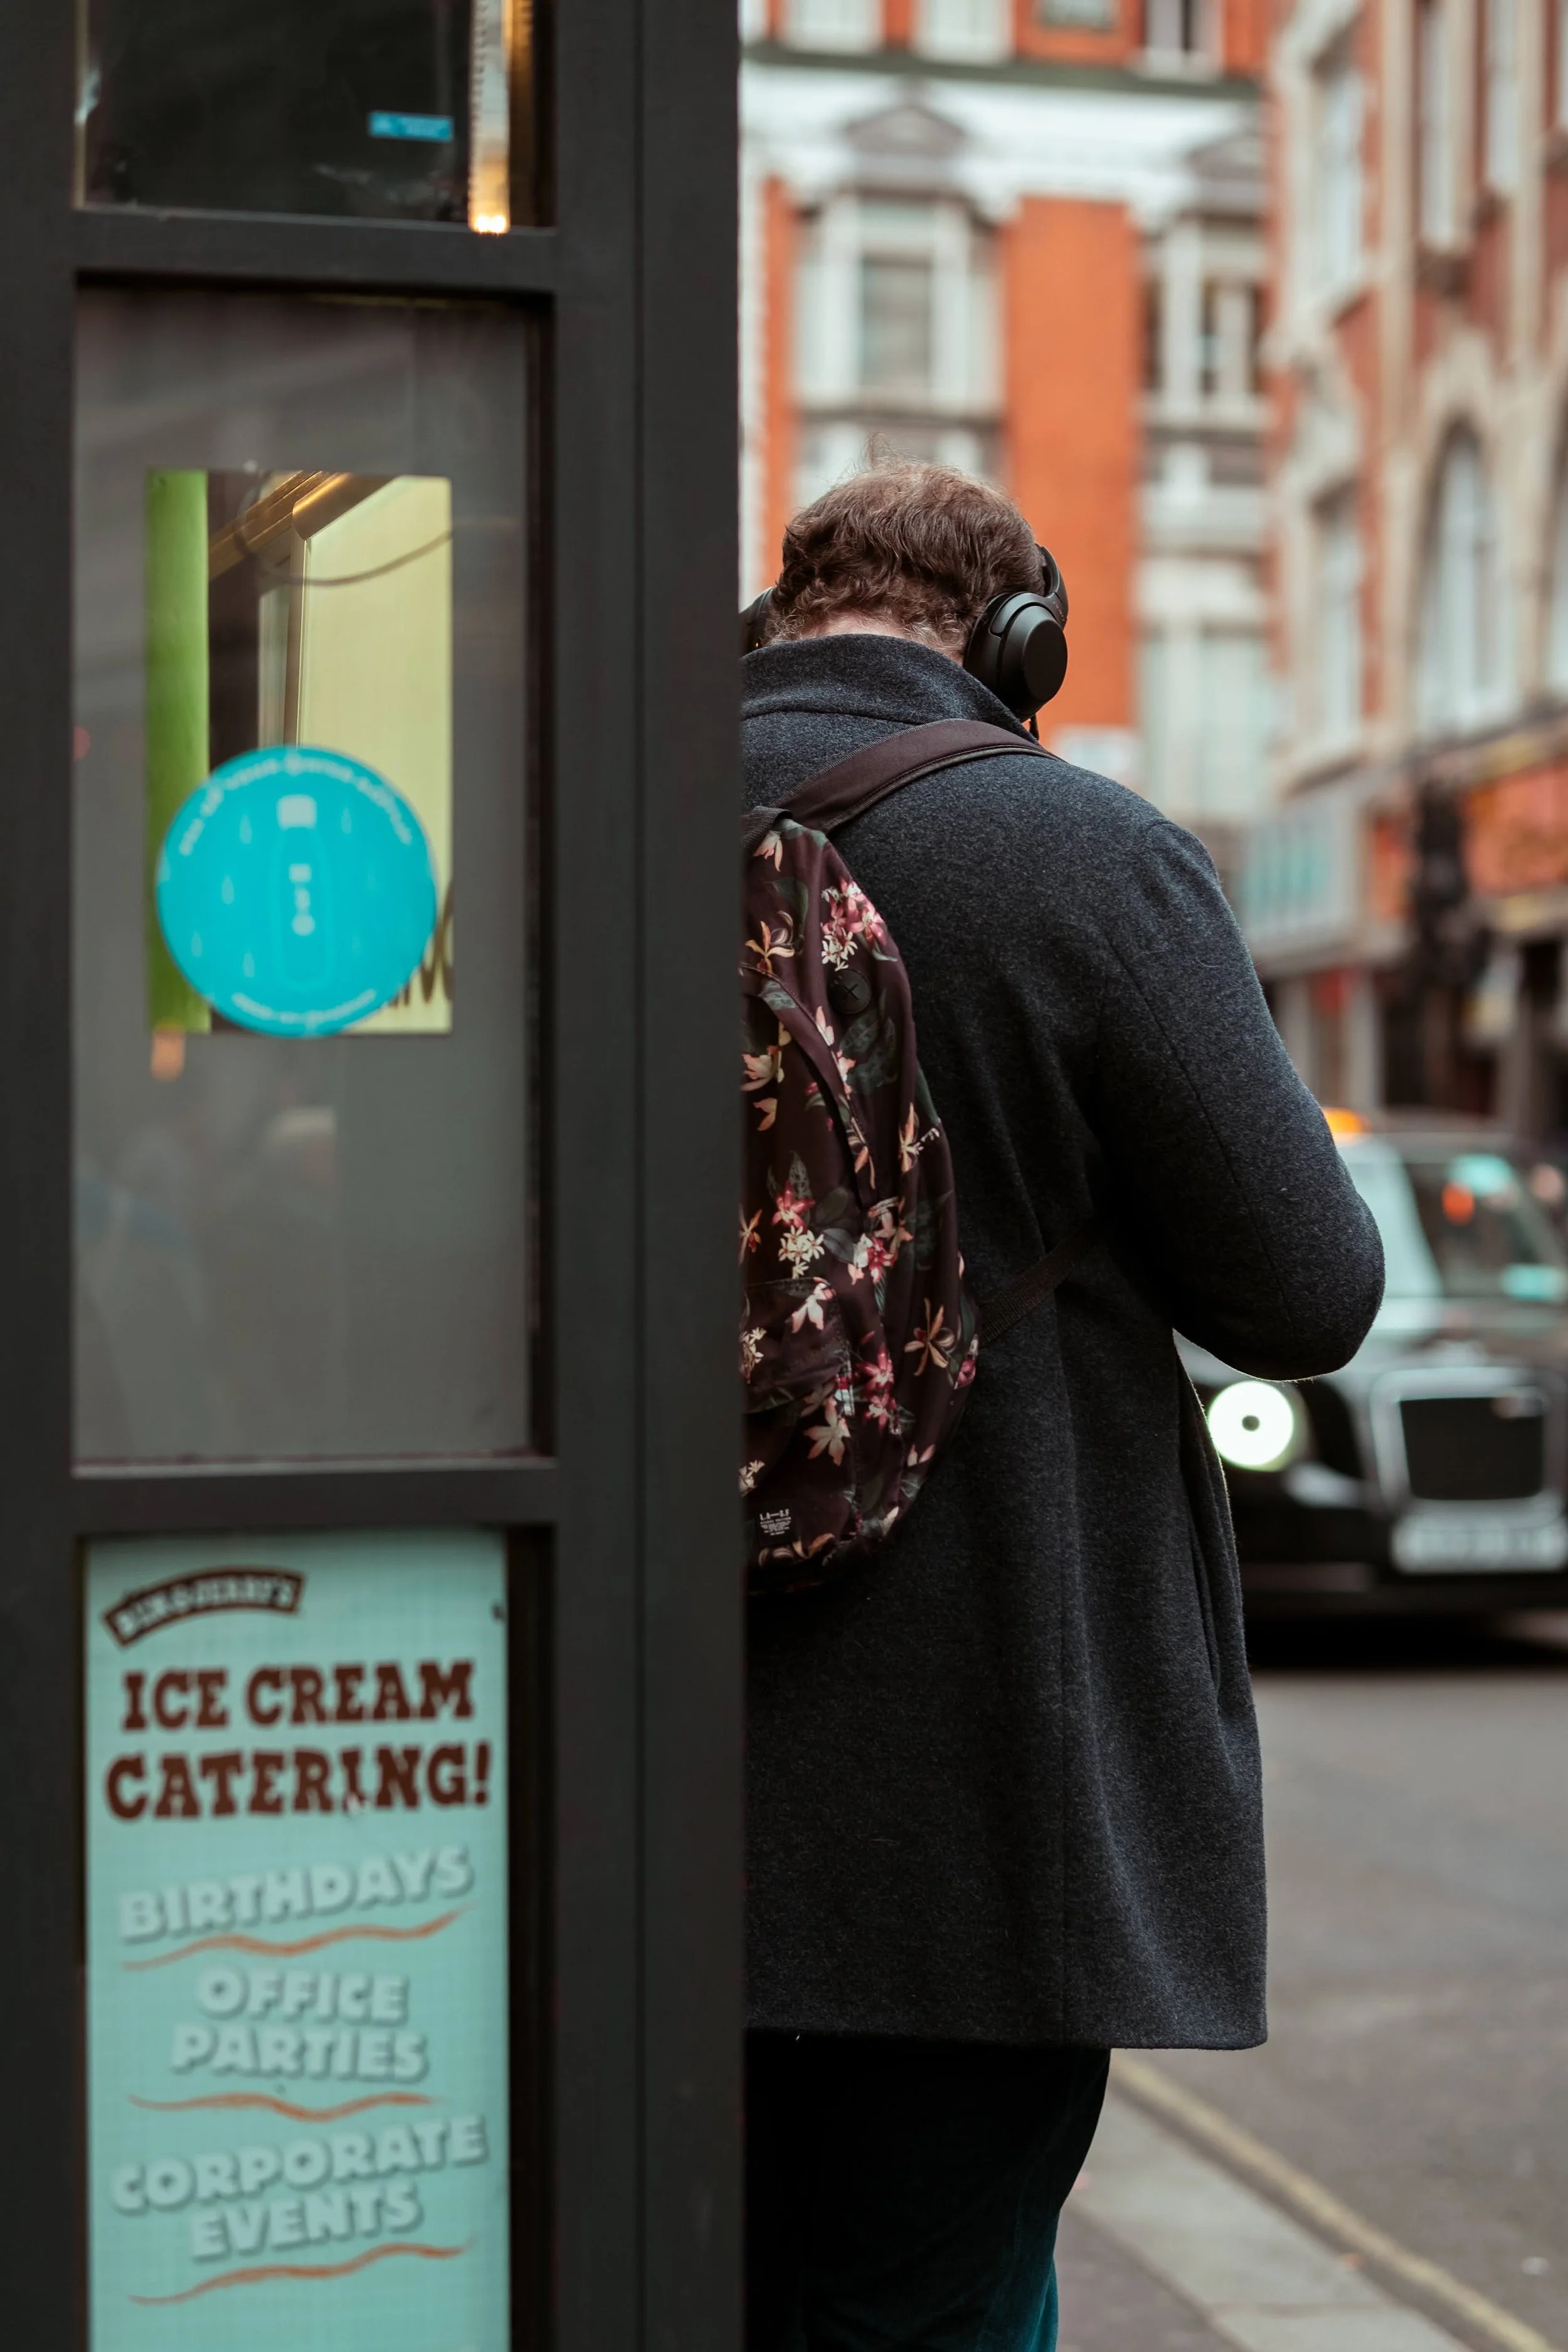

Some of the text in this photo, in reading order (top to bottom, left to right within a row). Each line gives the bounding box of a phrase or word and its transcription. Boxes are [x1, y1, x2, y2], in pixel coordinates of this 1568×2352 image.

[121, 1658, 475, 1731] ICE CREAM
[105, 1740, 491, 1821] CATERING!
[119, 1847, 474, 1942] BIRTHDAYS
[198, 1967, 408, 2025] OFFICE
[172, 2022, 428, 2083] PARTIES
[112, 2116, 487, 2215] CORPORATE
[192, 2183, 423, 2260] EVENTS
